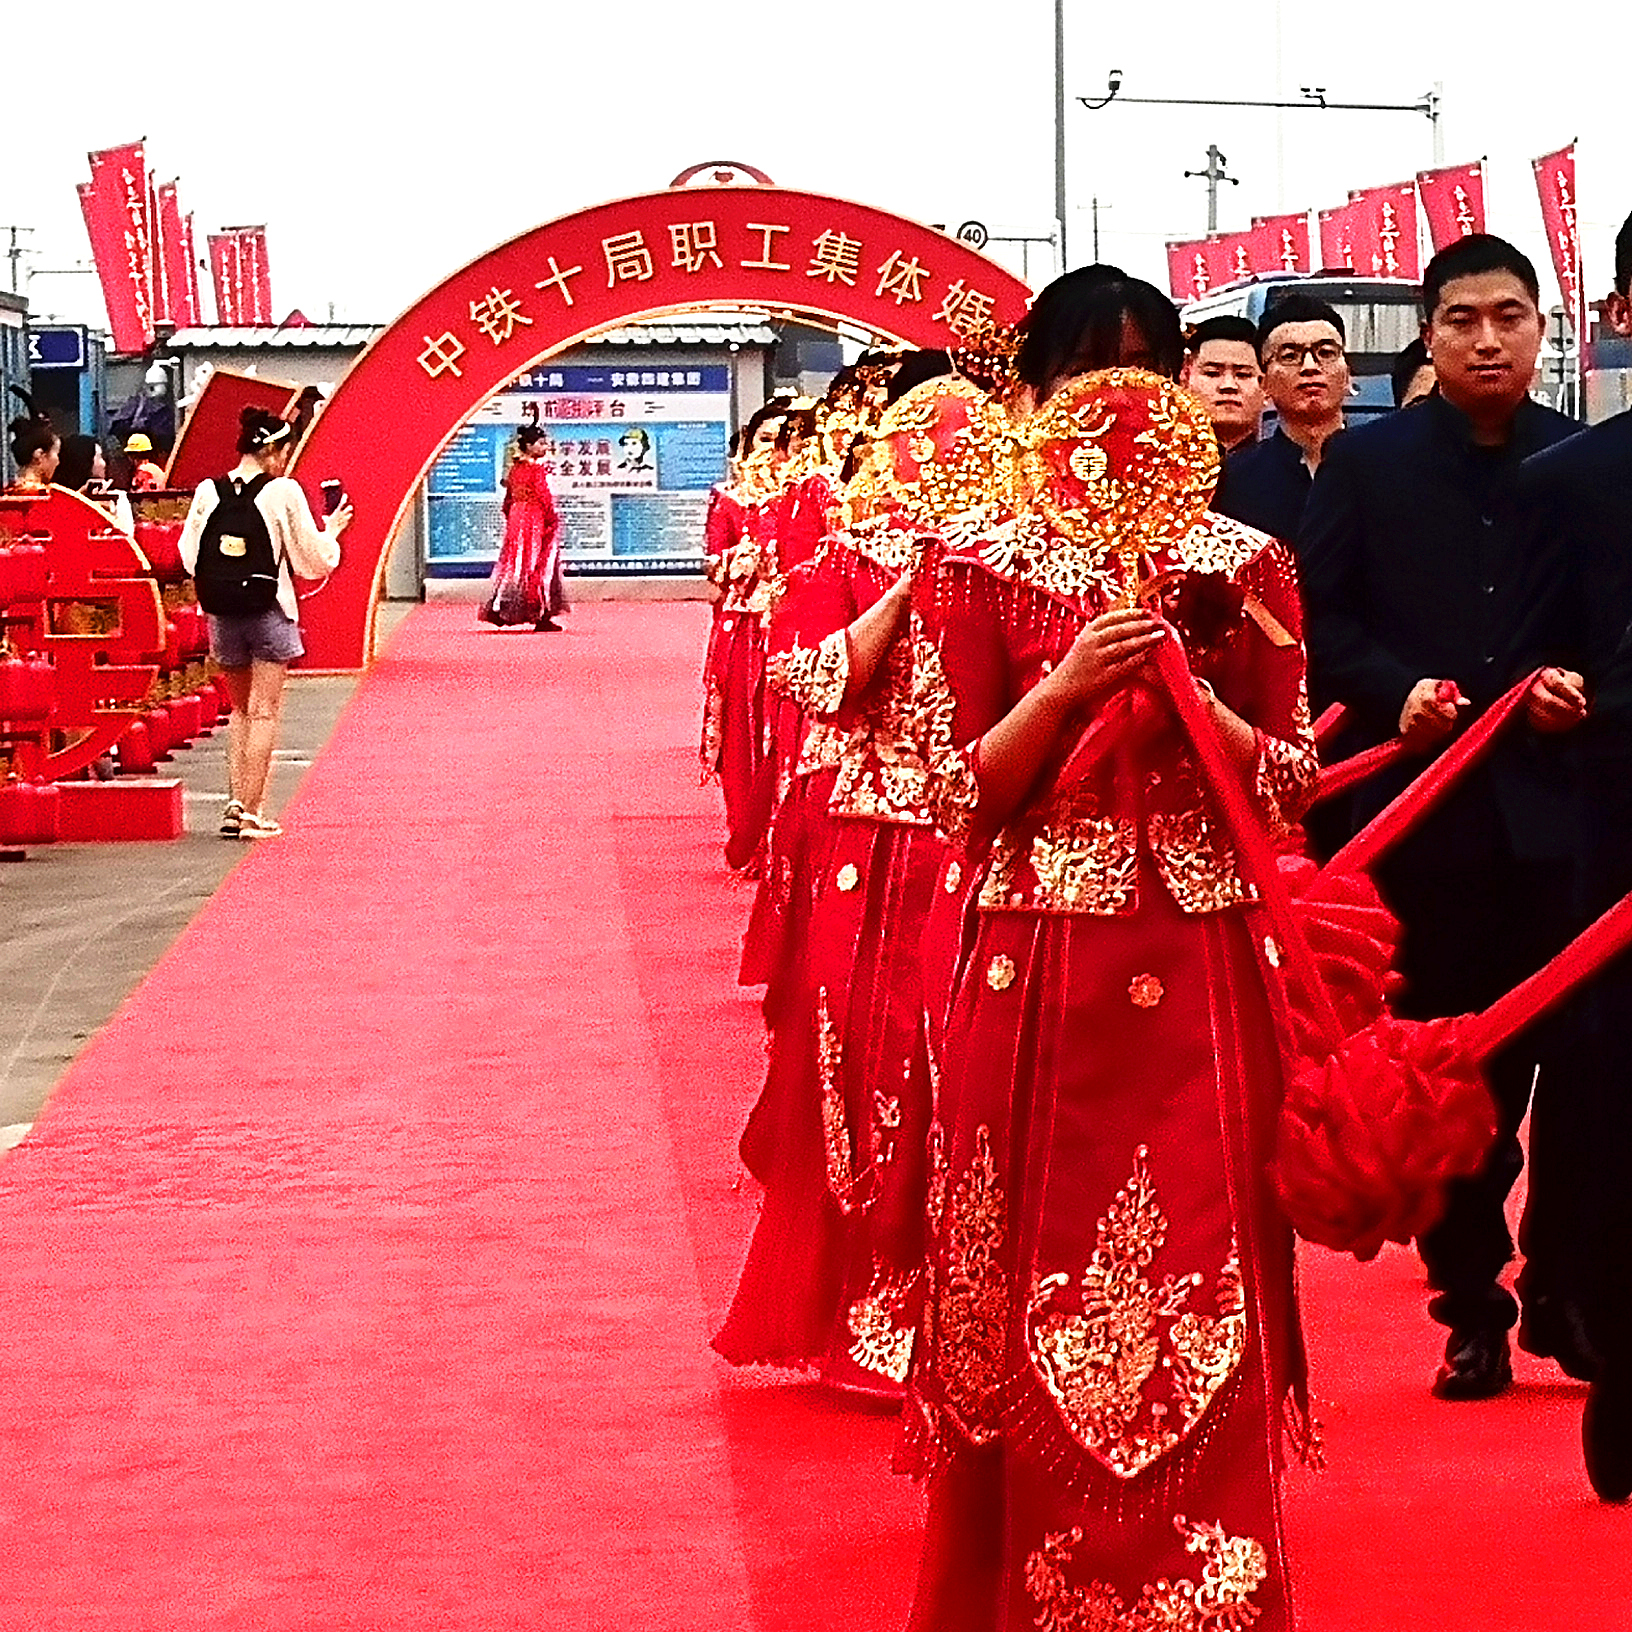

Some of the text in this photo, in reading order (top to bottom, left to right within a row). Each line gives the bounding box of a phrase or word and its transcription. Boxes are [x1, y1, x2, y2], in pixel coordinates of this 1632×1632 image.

[963, 228, 982, 243] 40
[416, 220, 1034, 378] 中铁十局职工集体婚
